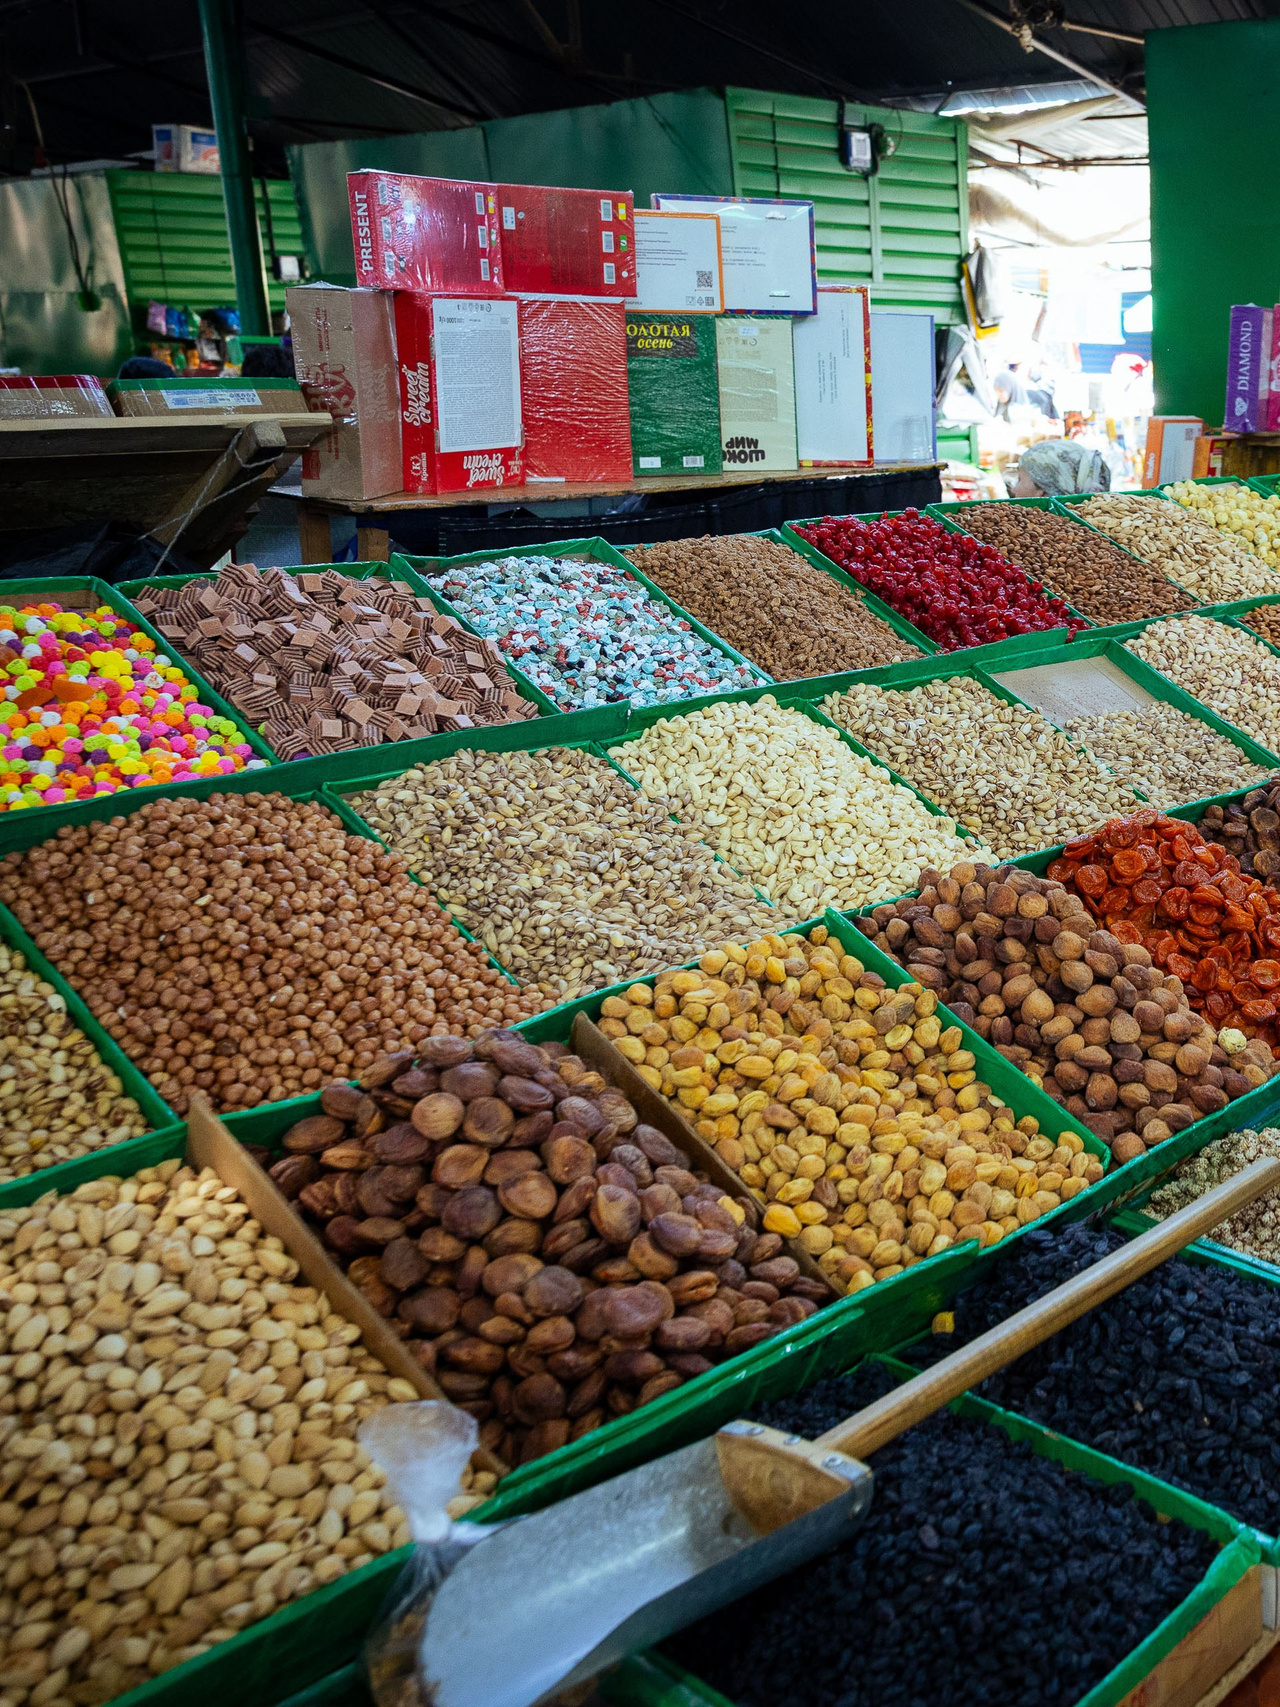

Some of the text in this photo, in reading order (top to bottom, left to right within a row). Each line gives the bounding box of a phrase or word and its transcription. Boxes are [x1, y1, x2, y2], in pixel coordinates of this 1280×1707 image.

[355, 190, 374, 271] PRESENT
[626, 323, 691, 337] ОЛОТАЯ
[637, 338, 674, 349] осень
[1237, 320, 1253, 391] DIAMOND
[401, 363, 421, 427] Sweet
[416, 361, 432, 424] cream
[725, 435, 760, 450] МИР
[411, 461, 421, 470] К
[462, 452, 503, 470] cream
[466, 465, 506, 488] Sweet
